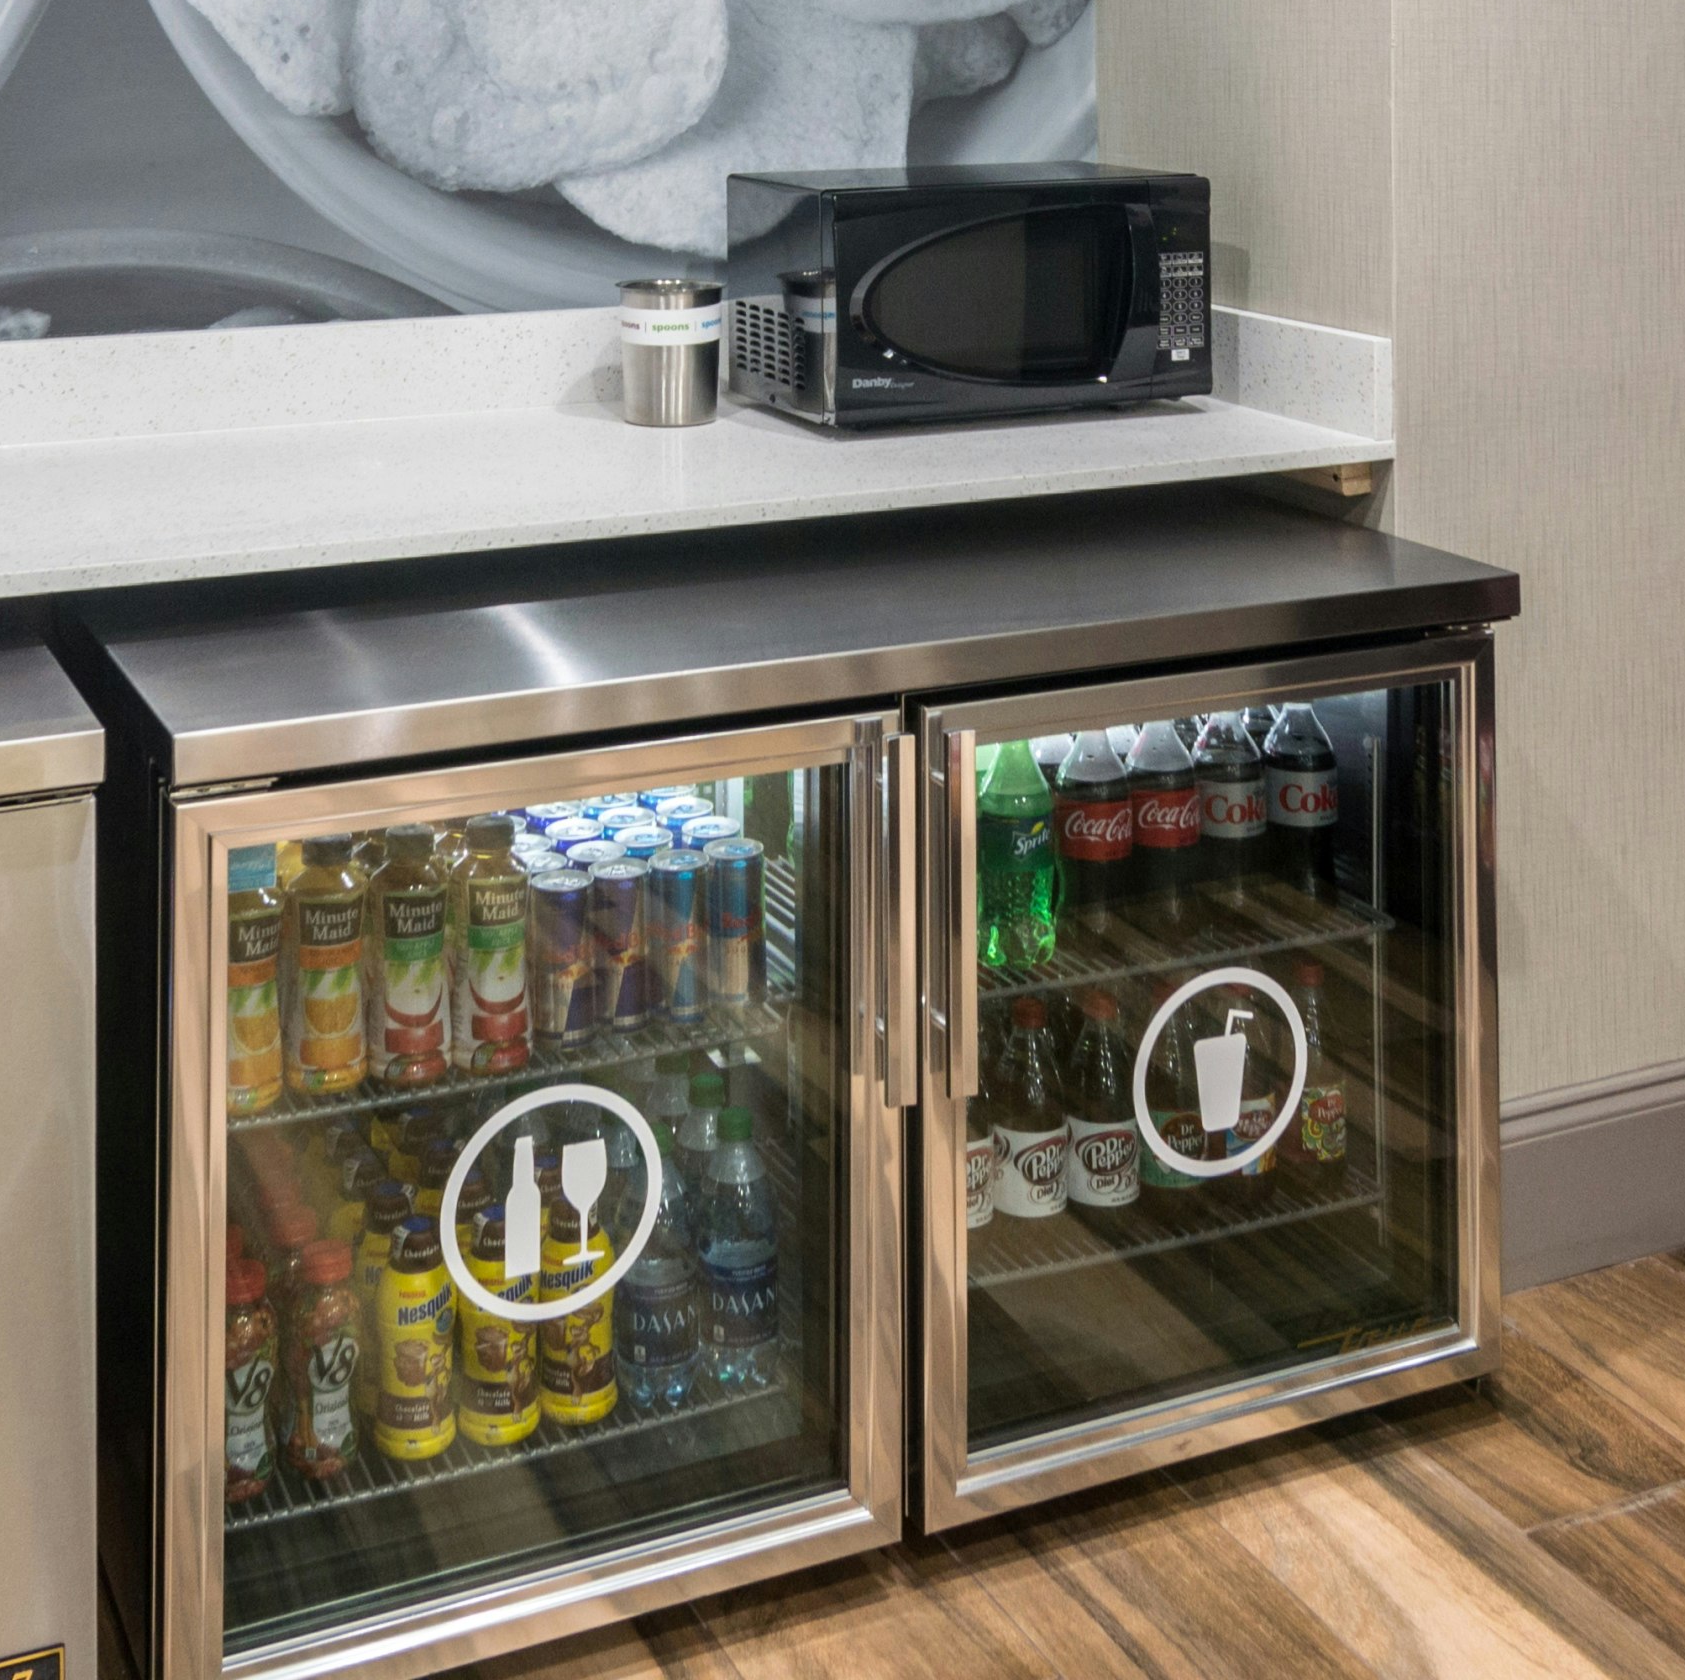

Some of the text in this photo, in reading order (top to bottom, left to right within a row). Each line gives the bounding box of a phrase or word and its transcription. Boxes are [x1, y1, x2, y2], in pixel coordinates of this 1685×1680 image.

[652, 321, 690, 332] spoons
[852, 377, 893, 389] Danby
[475, 888, 525, 905] Minute
[304, 906, 359, 924] Minute
[389, 900, 443, 918] Minute
[482, 904, 519, 921] Maid
[312, 924, 354, 941] Maid
[396, 917, 438, 934] Maid
[1181, 1123, 1195, 1134] Dr
[1167, 1133, 1203, 1153] Pepper
[1086, 1141, 1135, 1170] Pepper
[541, 1261, 594, 1289] Nesquik
[397, 1283, 453, 1327] Nesquik
[713, 1287, 776, 1317] DASAN
[634, 1304, 696, 1335] DASAN
[312, 1335, 355, 1384] V8
[226, 1356, 271, 1407] V8
